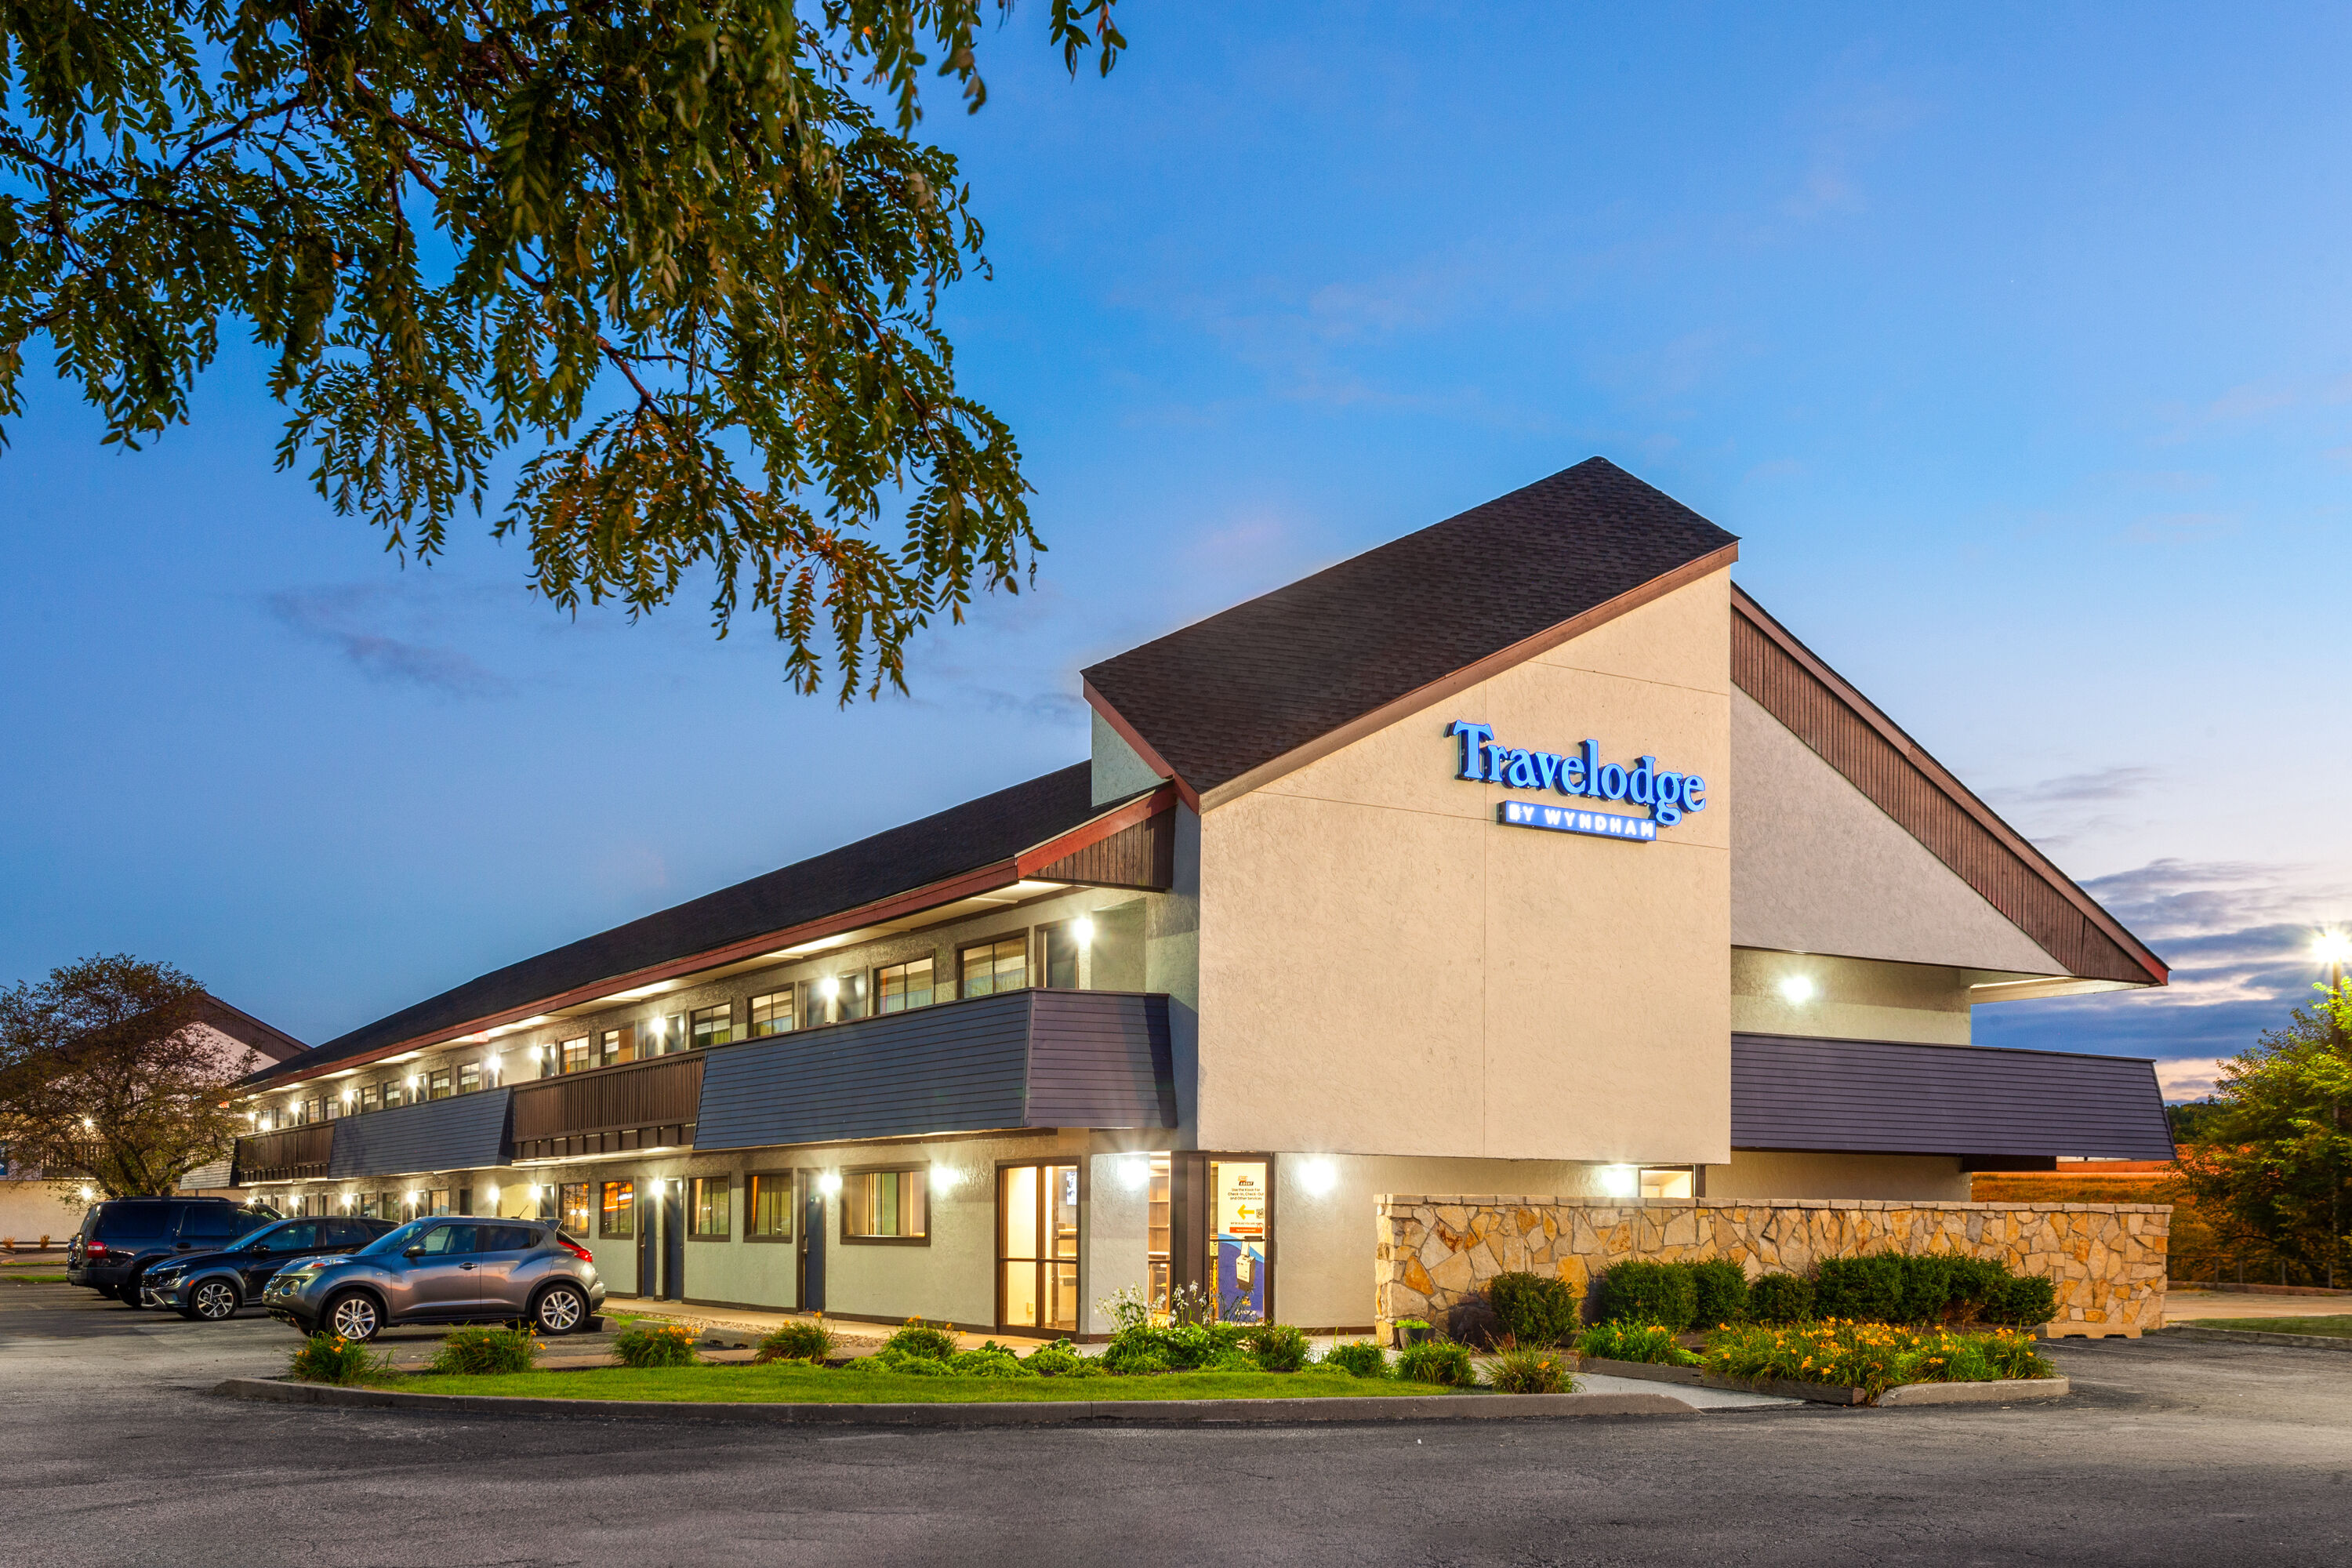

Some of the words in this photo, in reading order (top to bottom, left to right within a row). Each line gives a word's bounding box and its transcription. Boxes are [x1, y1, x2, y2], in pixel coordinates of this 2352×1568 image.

[1445, 719, 1706, 826] Travelodge
[1508, 804, 1534, 822] BY
[1544, 808, 1653, 837] WYNDHAM
